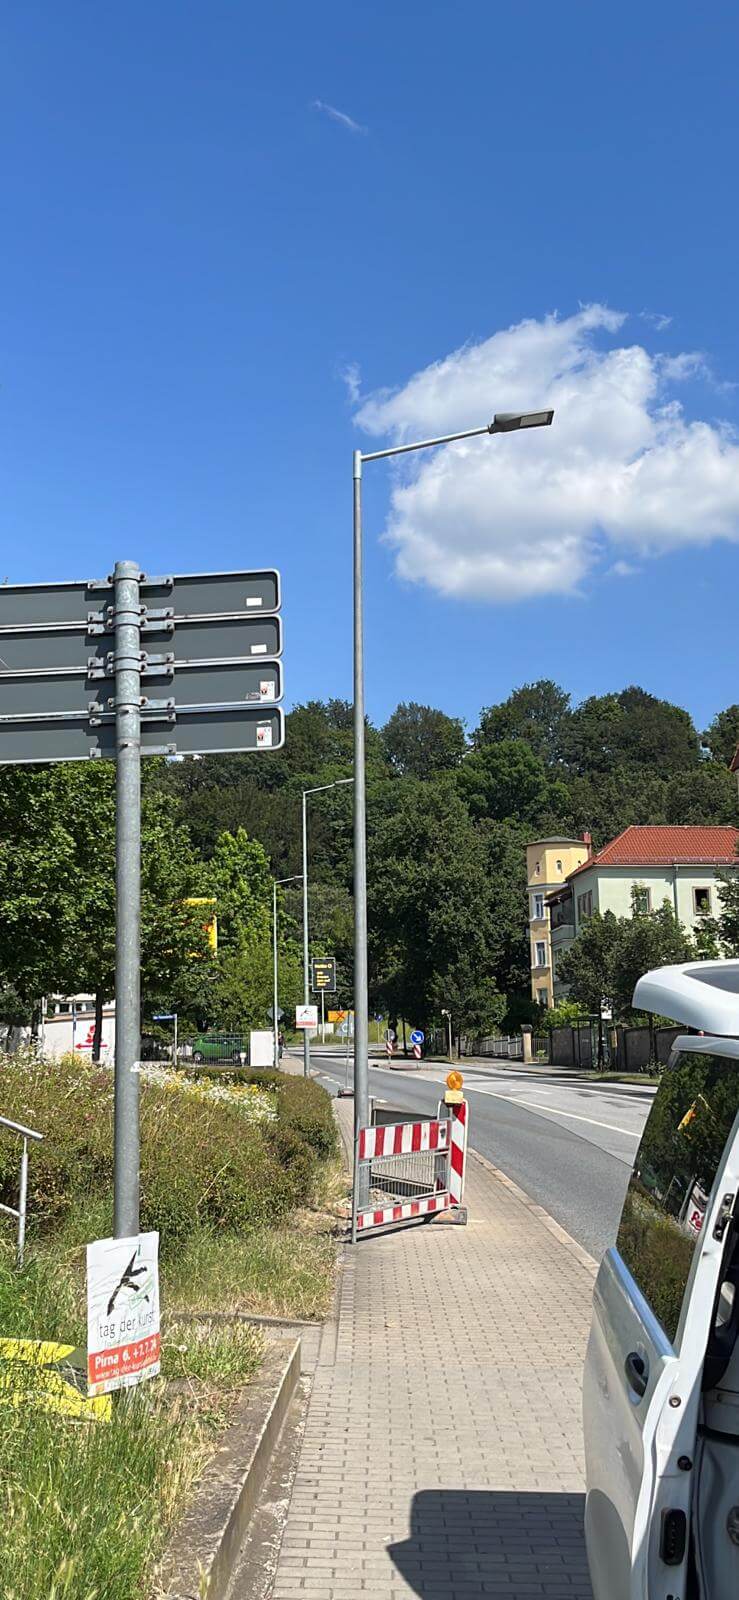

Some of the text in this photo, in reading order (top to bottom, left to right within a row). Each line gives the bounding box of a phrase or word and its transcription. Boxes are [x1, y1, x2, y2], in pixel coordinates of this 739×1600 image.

[99, 1323, 115, 1339] tag
[119, 1316, 136, 1332] der
[94, 1354, 119, 1370] Pirna
[122, 1349, 131, 1361] 6.
